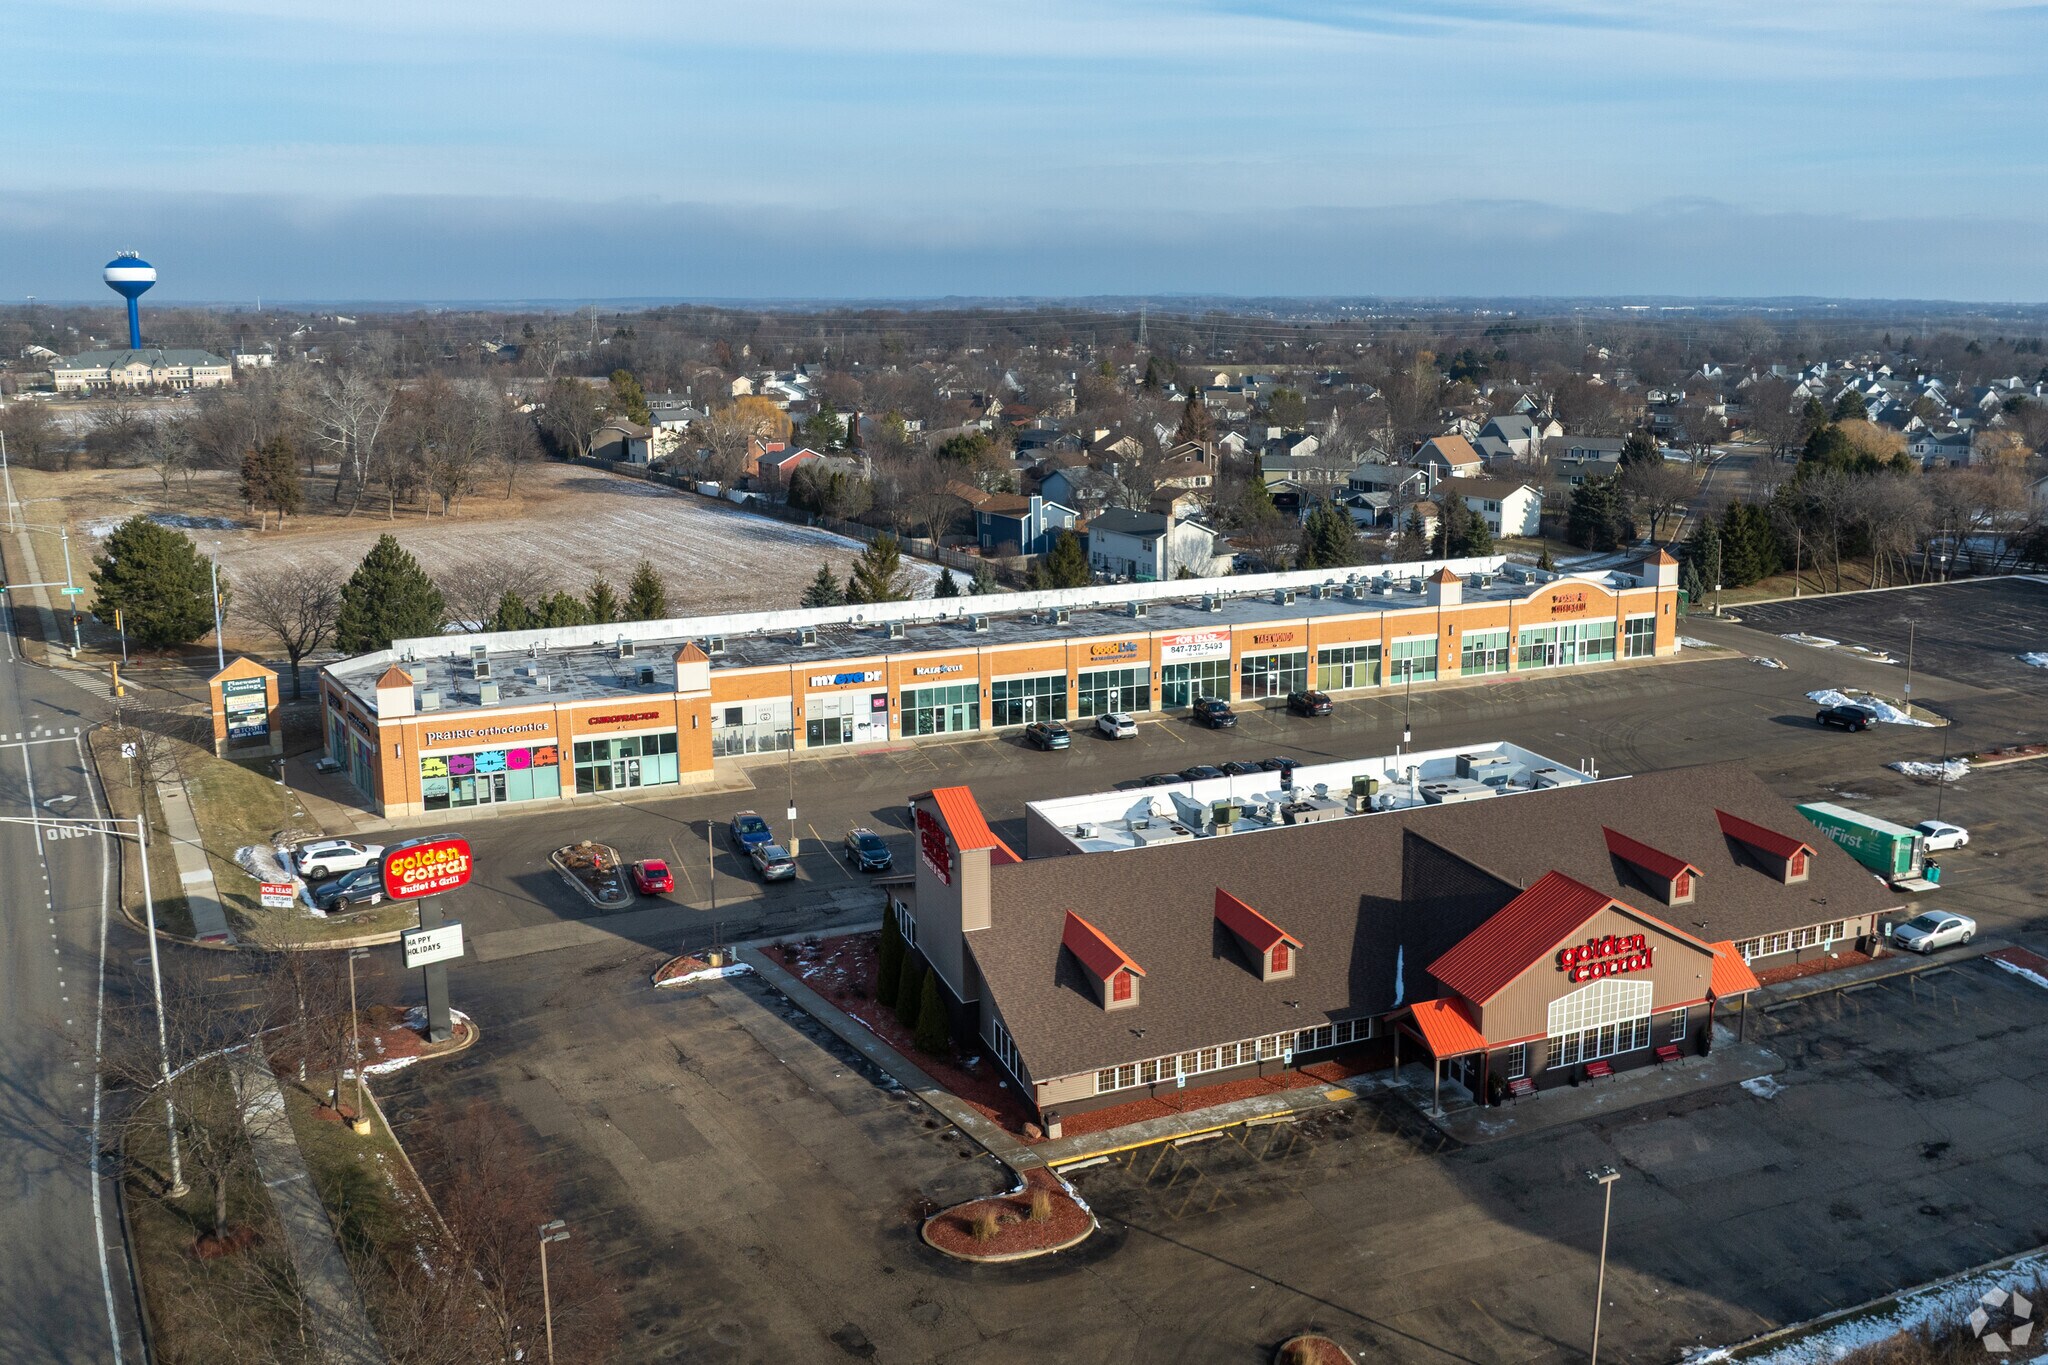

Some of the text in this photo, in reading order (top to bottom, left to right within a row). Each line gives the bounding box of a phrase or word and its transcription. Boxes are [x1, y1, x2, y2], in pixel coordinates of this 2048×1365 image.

[1175, 635, 1193, 645] FOR
[227, 677, 261, 687] Pinewood
[227, 684, 261, 692] Crossings
[478, 722, 549, 737] orthodontics
[47, 824, 94, 840] ONLY
[391, 847, 460, 877] golden
[403, 856, 468, 883] corral
[400, 875, 460, 895] Buffet & Grill
[407, 935, 431, 946] HAPPY
[407, 943, 441, 956] HOLIDAYS
[1559, 934, 1646, 972] golden
[1572, 948, 1653, 983] corral
